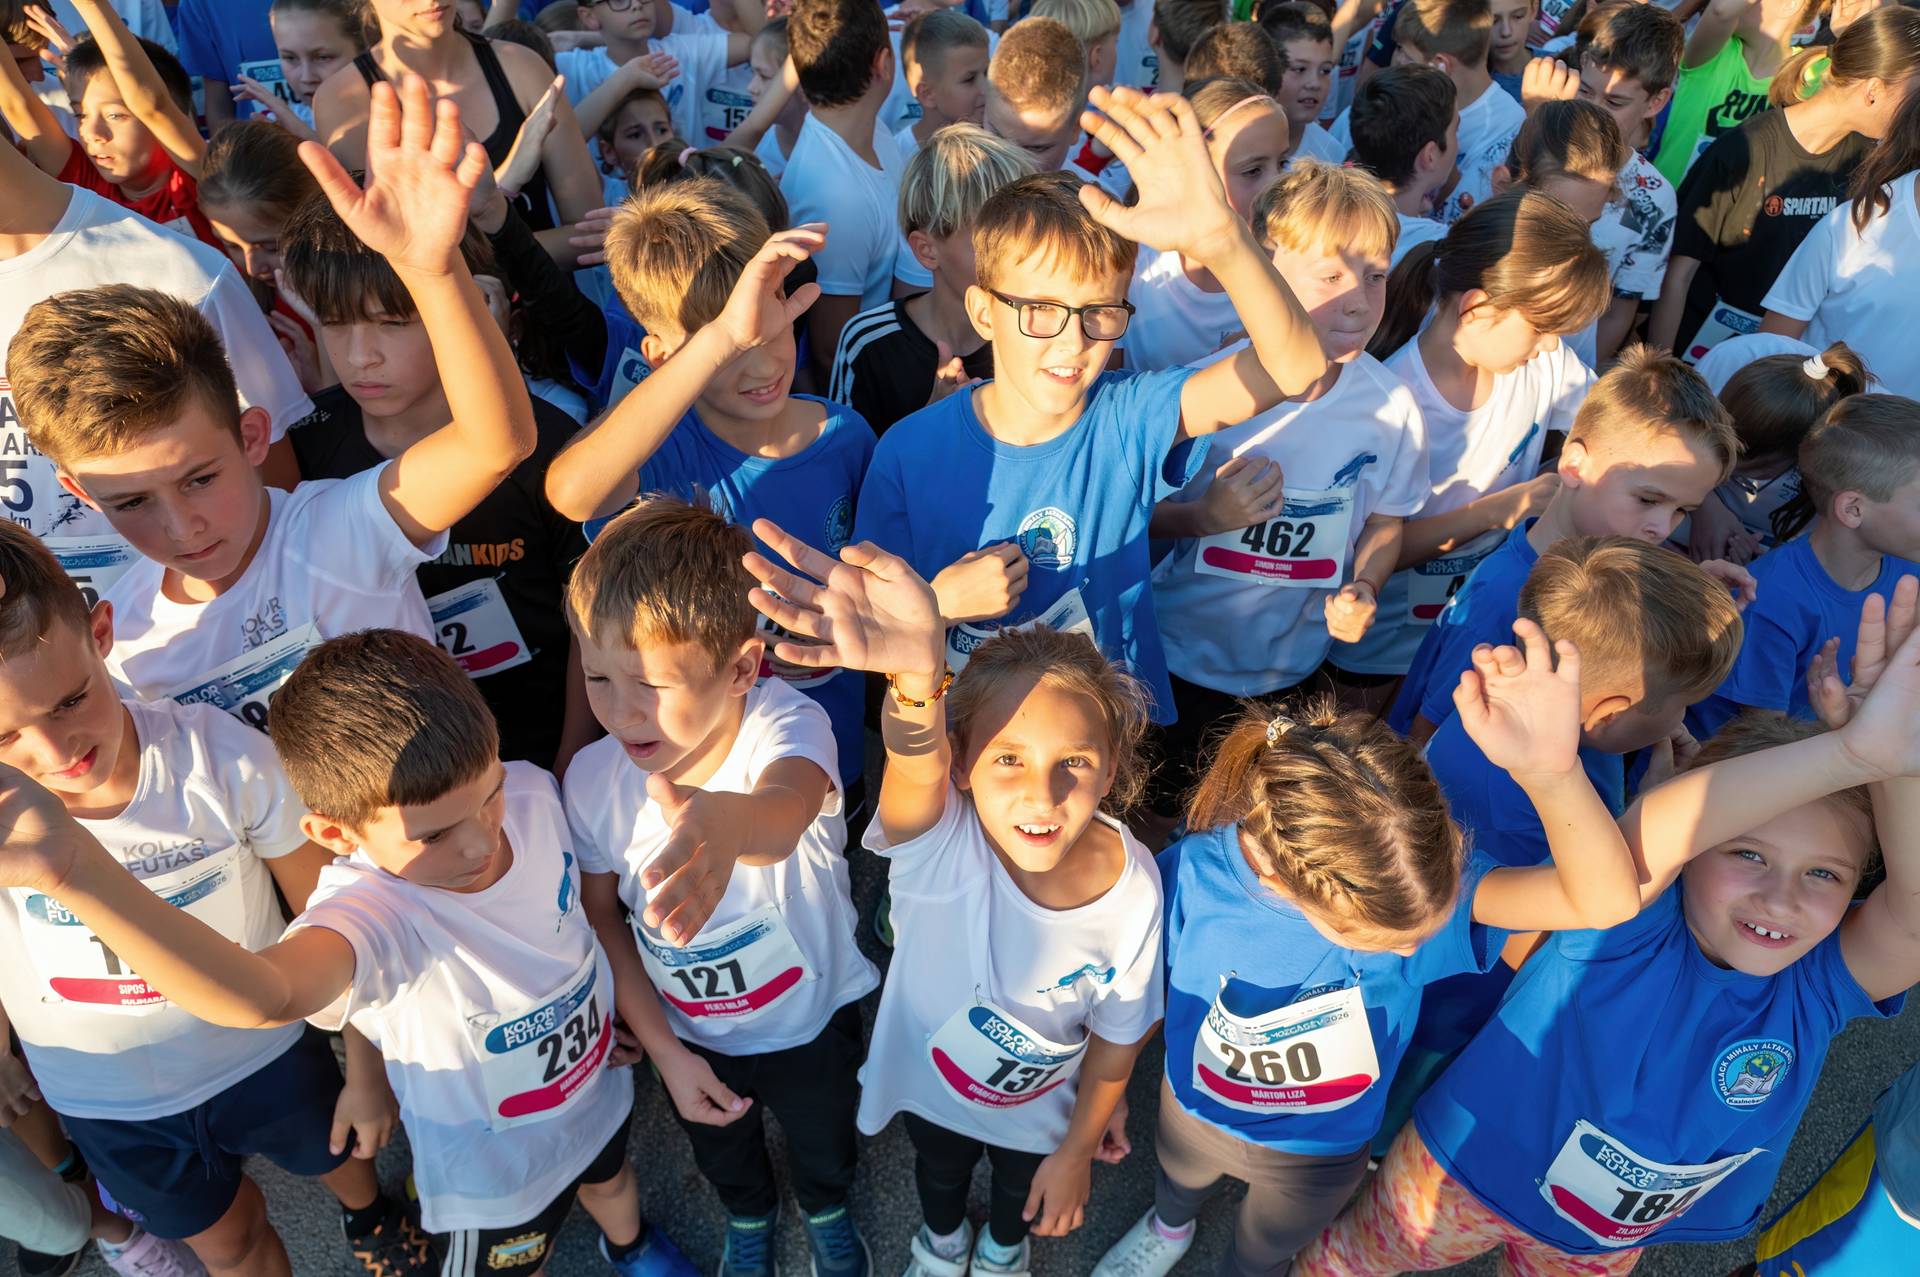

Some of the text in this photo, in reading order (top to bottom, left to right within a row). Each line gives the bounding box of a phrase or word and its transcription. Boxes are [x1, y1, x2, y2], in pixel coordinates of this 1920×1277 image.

[723, 107, 752, 128] 15
[1783, 196, 1837, 216] SPARTAN
[1240, 520, 1316, 558] 462
[435, 622, 476, 655] 2
[118, 983, 145, 995] SIPOS
[671, 958, 747, 999] 127
[503, 1006, 555, 1039] KOLOR
[987, 1015, 1036, 1056] KOLOR
[1325, 1011, 1349, 1024] 2026
[537, 993, 600, 1084] 234
[985, 1056, 1065, 1094] 131
[1220, 1041, 1322, 1085] 260
[1717, 1060, 1729, 1097] POLLACK
[1726, 1044, 1760, 1061] MIHÁLY
[1250, 1089, 1306, 1100] MÁRTON LIZA
[1600, 1144, 1659, 1183] KOLOR
[1611, 1185, 1703, 1224] 184
